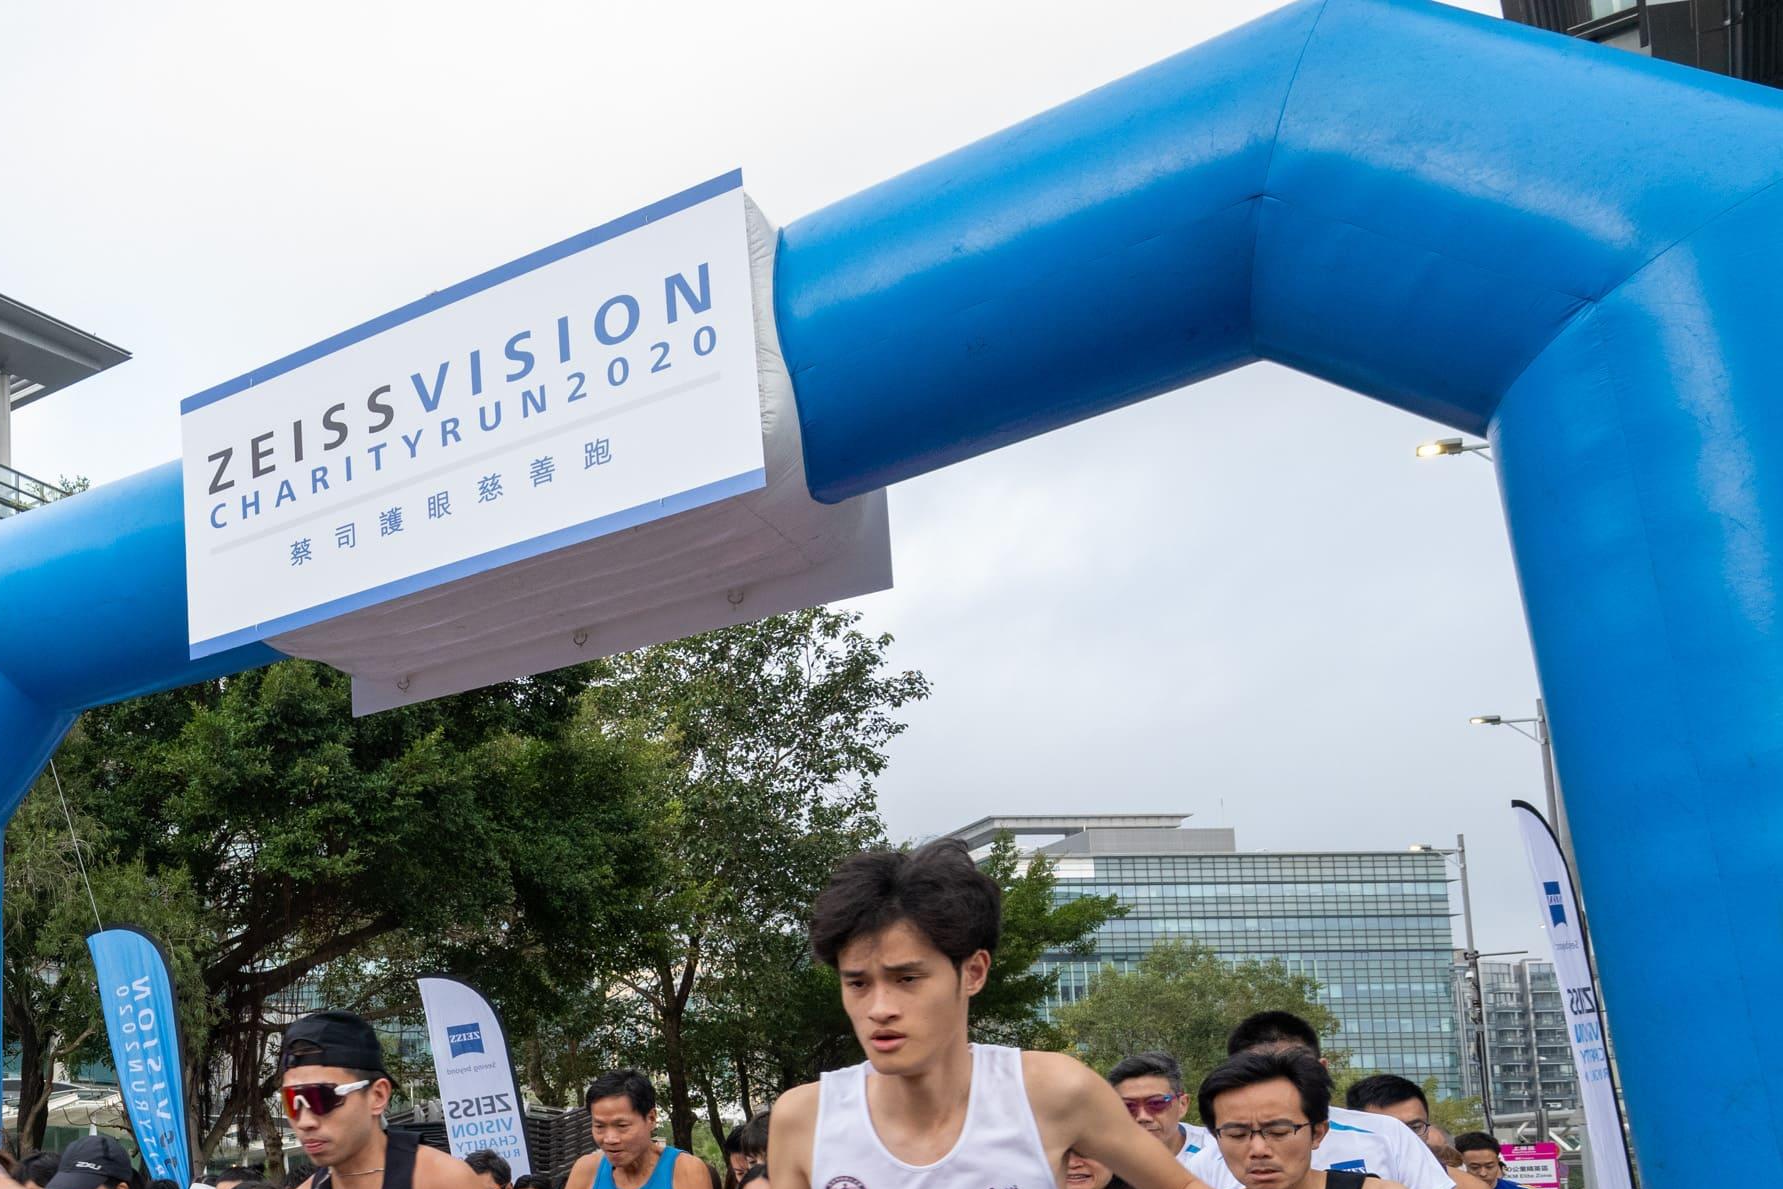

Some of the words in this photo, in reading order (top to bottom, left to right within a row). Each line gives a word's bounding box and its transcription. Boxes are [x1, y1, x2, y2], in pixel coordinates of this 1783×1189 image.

[289, 436, 613, 567] 蔡司護眼慈善跑
